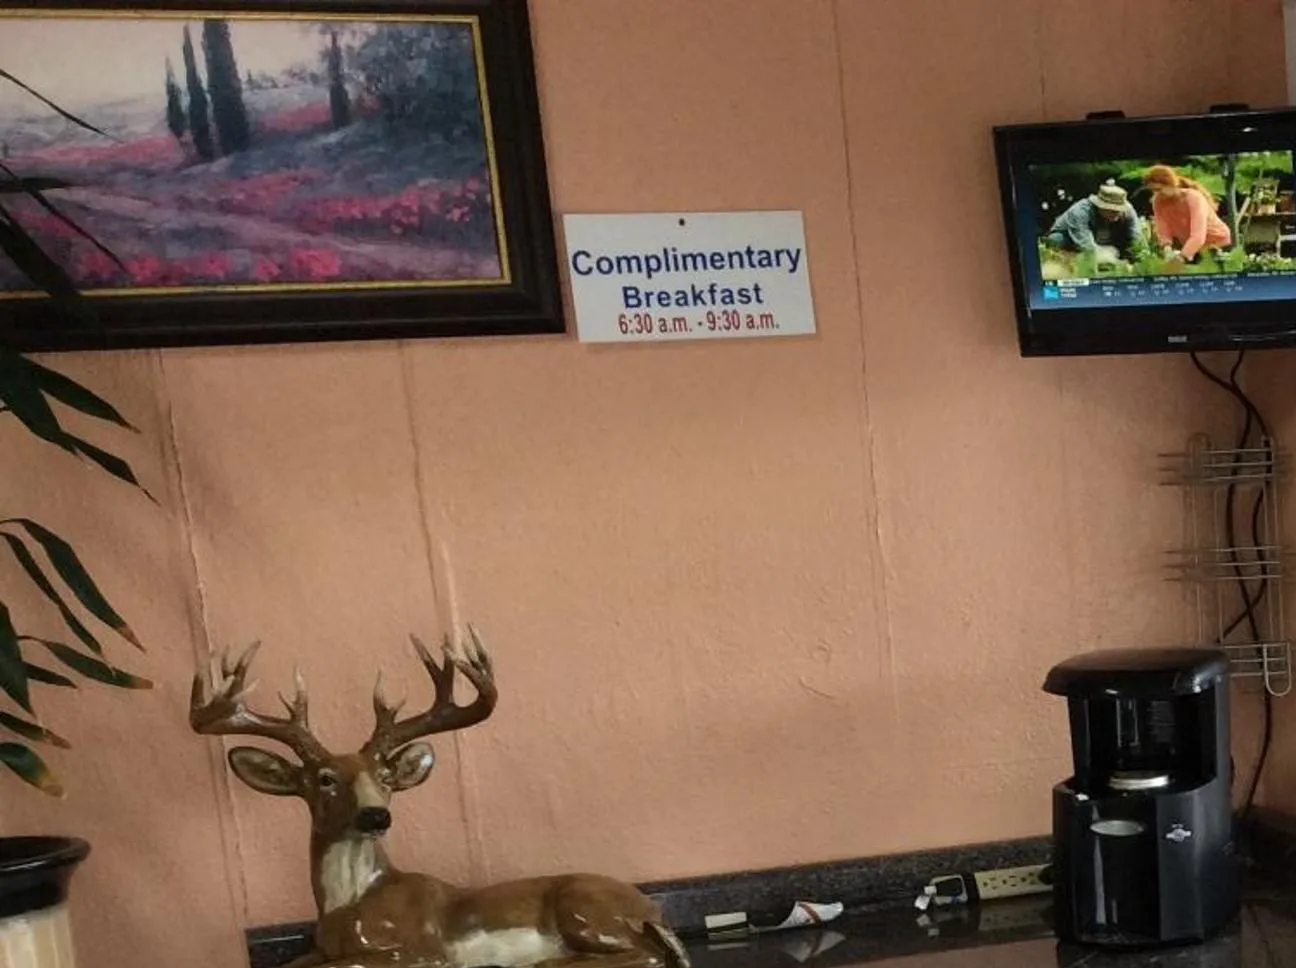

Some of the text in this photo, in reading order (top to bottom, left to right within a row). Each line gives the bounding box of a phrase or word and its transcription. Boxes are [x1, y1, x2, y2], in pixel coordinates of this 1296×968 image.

[571, 246, 801, 279] Complimentary
[621, 282, 764, 309] Breakfast
[618, 313, 653, 334] 6:30
[658, 315, 693, 333] a.m.
[706, 310, 741, 331] 9:30
[745, 311, 780, 330] a.m.
